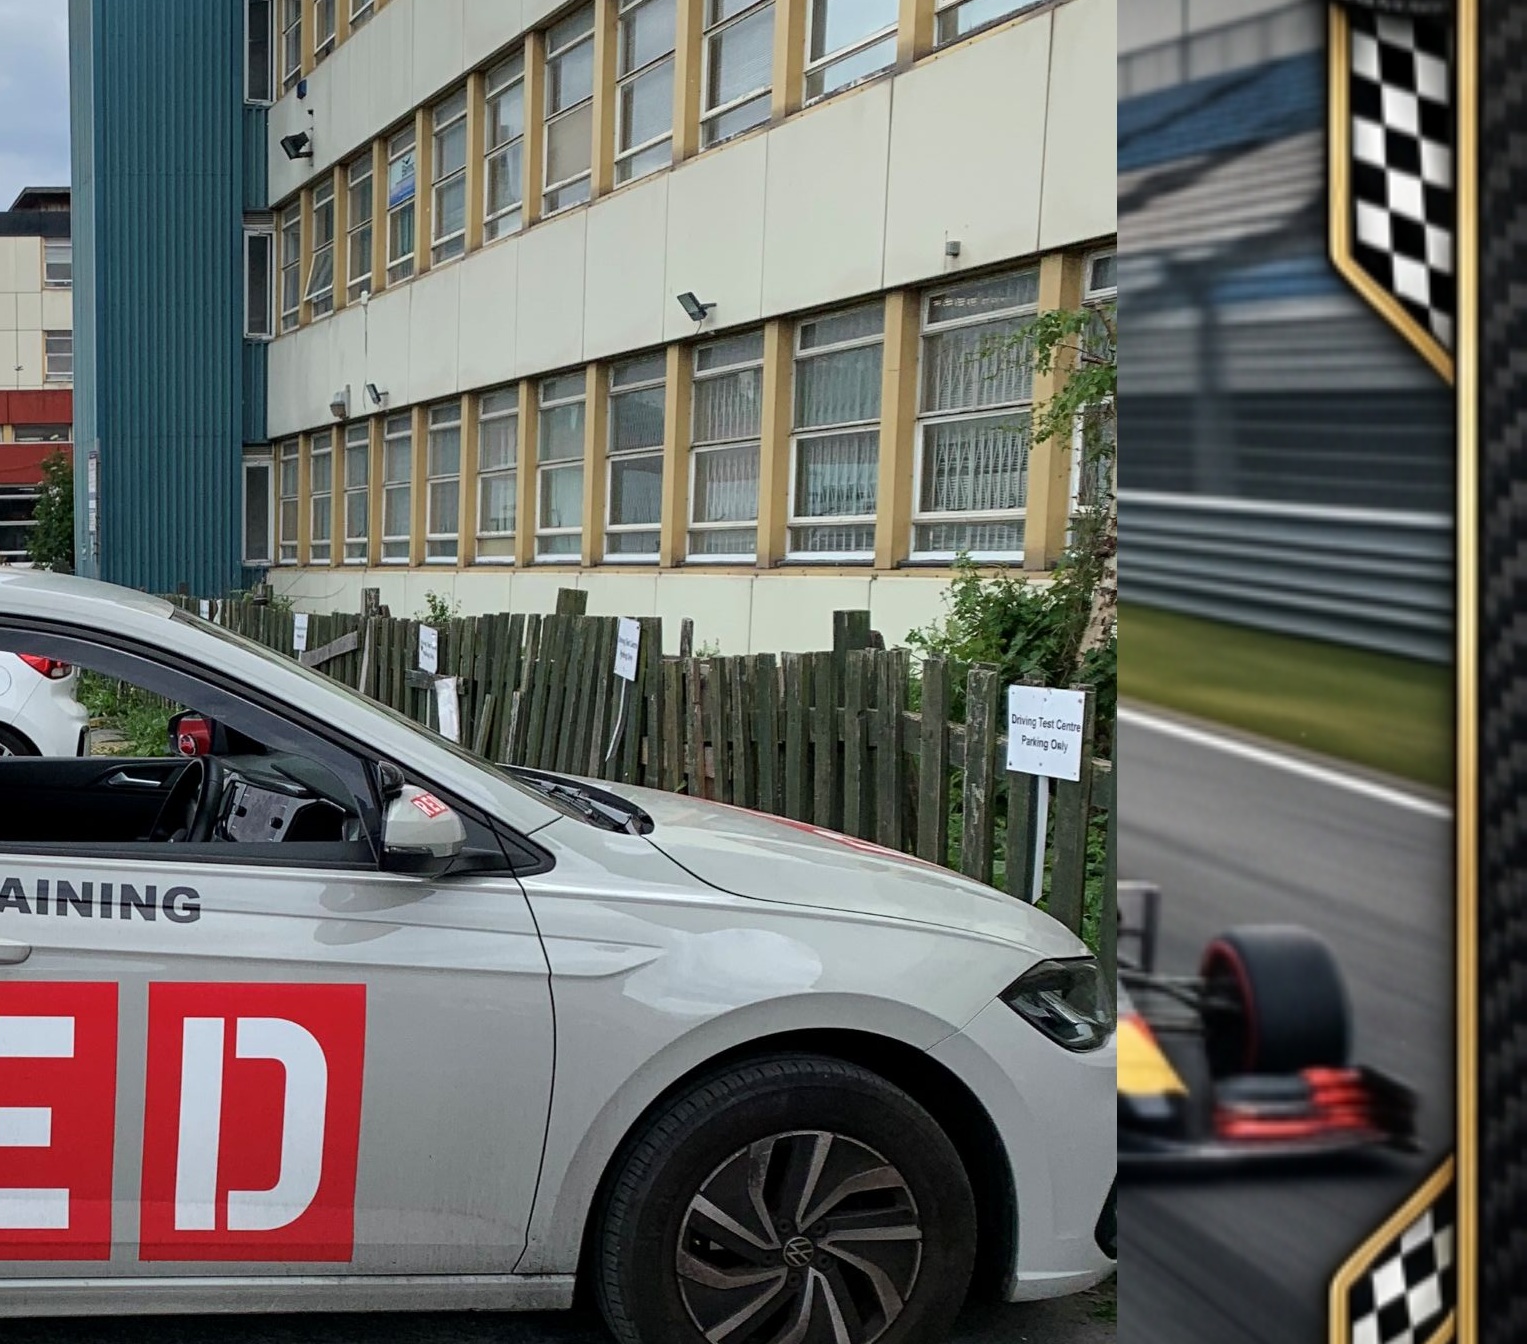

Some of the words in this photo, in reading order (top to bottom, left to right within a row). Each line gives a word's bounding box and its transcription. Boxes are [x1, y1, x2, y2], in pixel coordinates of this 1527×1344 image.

[1011, 713, 1037, 729] Driving
[1038, 716, 1055, 729] Test
[1056, 719, 1081, 732] Centre
[1021, 735, 1049, 751] Parking
[1050, 739, 1069, 754] Only
[412, 796, 447, 816] RED
